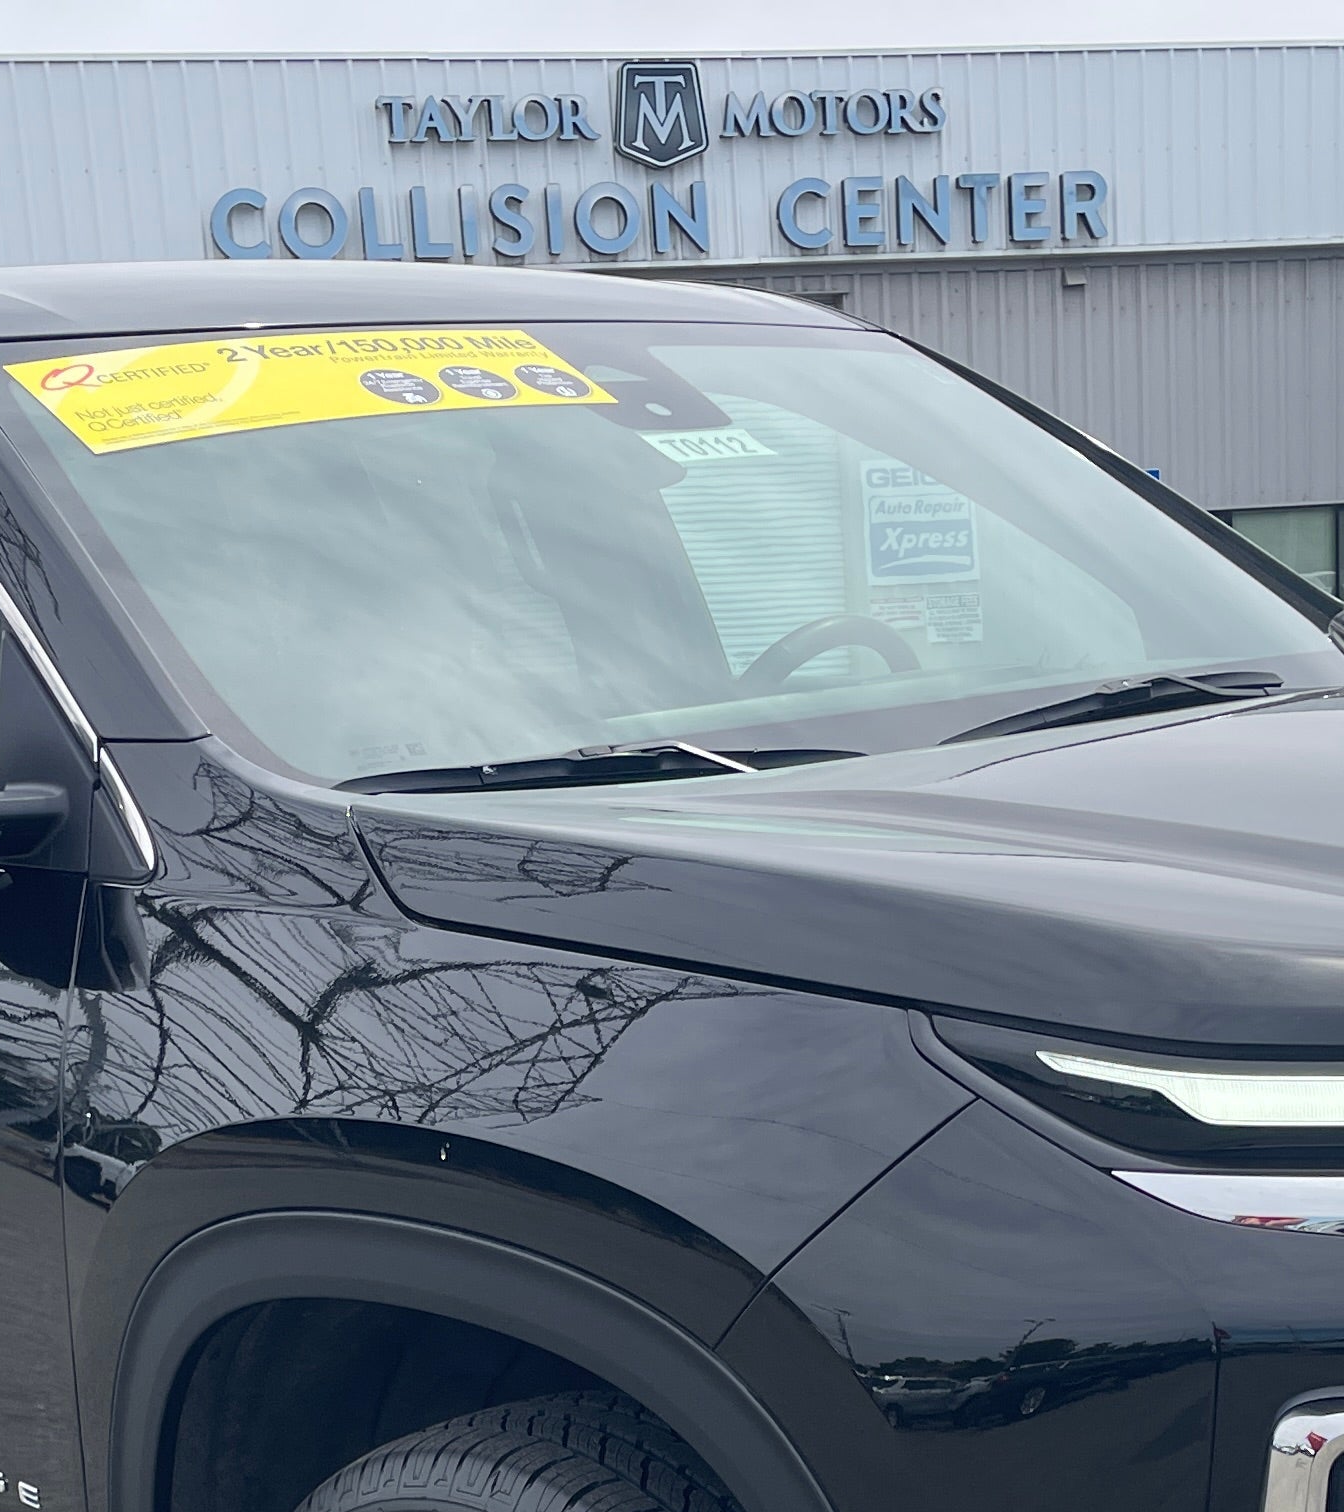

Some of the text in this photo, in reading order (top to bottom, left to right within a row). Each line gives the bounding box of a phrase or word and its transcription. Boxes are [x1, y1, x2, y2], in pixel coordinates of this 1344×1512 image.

[375, 92, 601, 145] TAYLOR
[721, 87, 947, 140] MOTORS
[210, 169, 1109, 260] COLLISION CENTER
[217, 347, 248, 363] 2
[463, 335, 537, 350] Mile
[329, 348, 549, 364] Powertrain Limited Warranty
[74, 408, 114, 422] Not
[113, 402, 148, 418] just
[866, 466, 941, 489] GEIC
[875, 495, 966, 518] Auto Repair
[879, 527, 969, 558] Xpress
